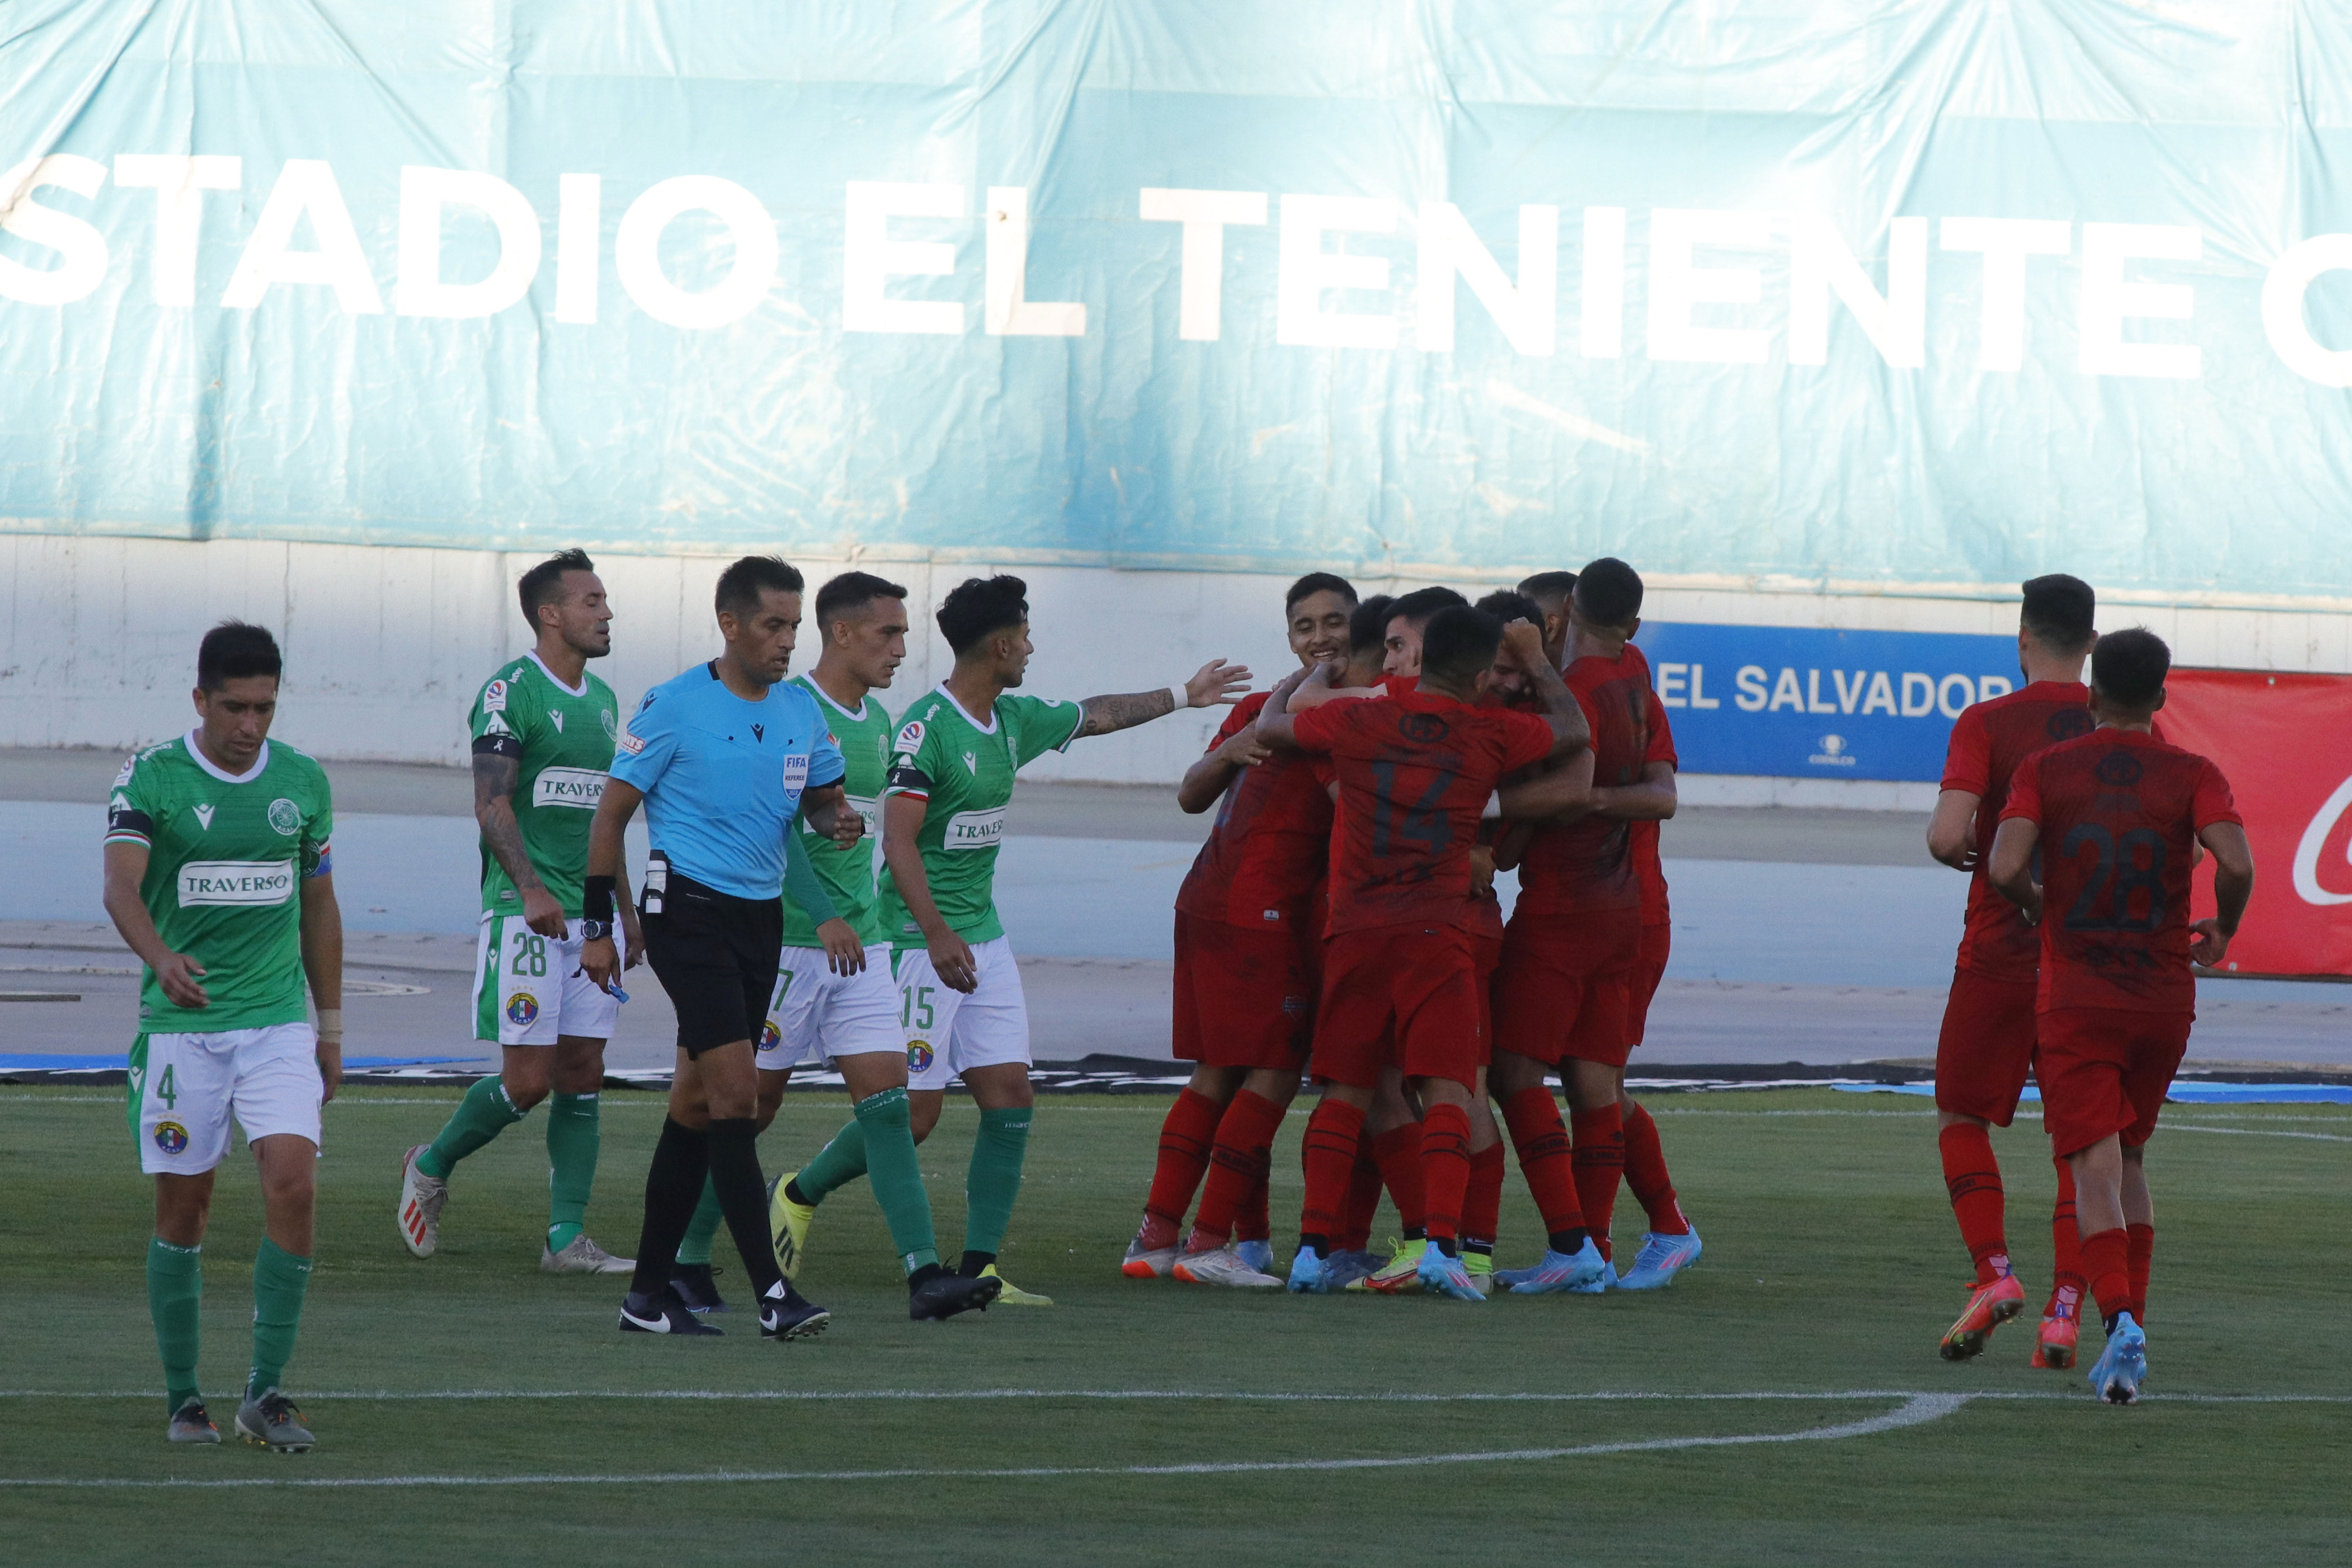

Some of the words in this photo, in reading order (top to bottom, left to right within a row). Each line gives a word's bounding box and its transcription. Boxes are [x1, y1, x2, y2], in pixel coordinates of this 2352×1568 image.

[0, 153, 779, 329] STADIO
[842, 179, 1086, 336] EL
[1139, 187, 2203, 379] TENIENTE
[1657, 663, 1719, 709] EL
[786, 757, 806, 768] FIFA
[543, 780, 604, 796] TRAVER
[1371, 760, 1458, 858] 14
[956, 819, 1003, 838] TRAVER
[186, 875, 288, 893] TRAVERSO
[2063, 822, 2167, 933] 28
[512, 932, 546, 977] 28
[773, 967, 794, 1011] 7
[903, 985, 935, 1029] 15
[157, 1063, 177, 1110] 4
